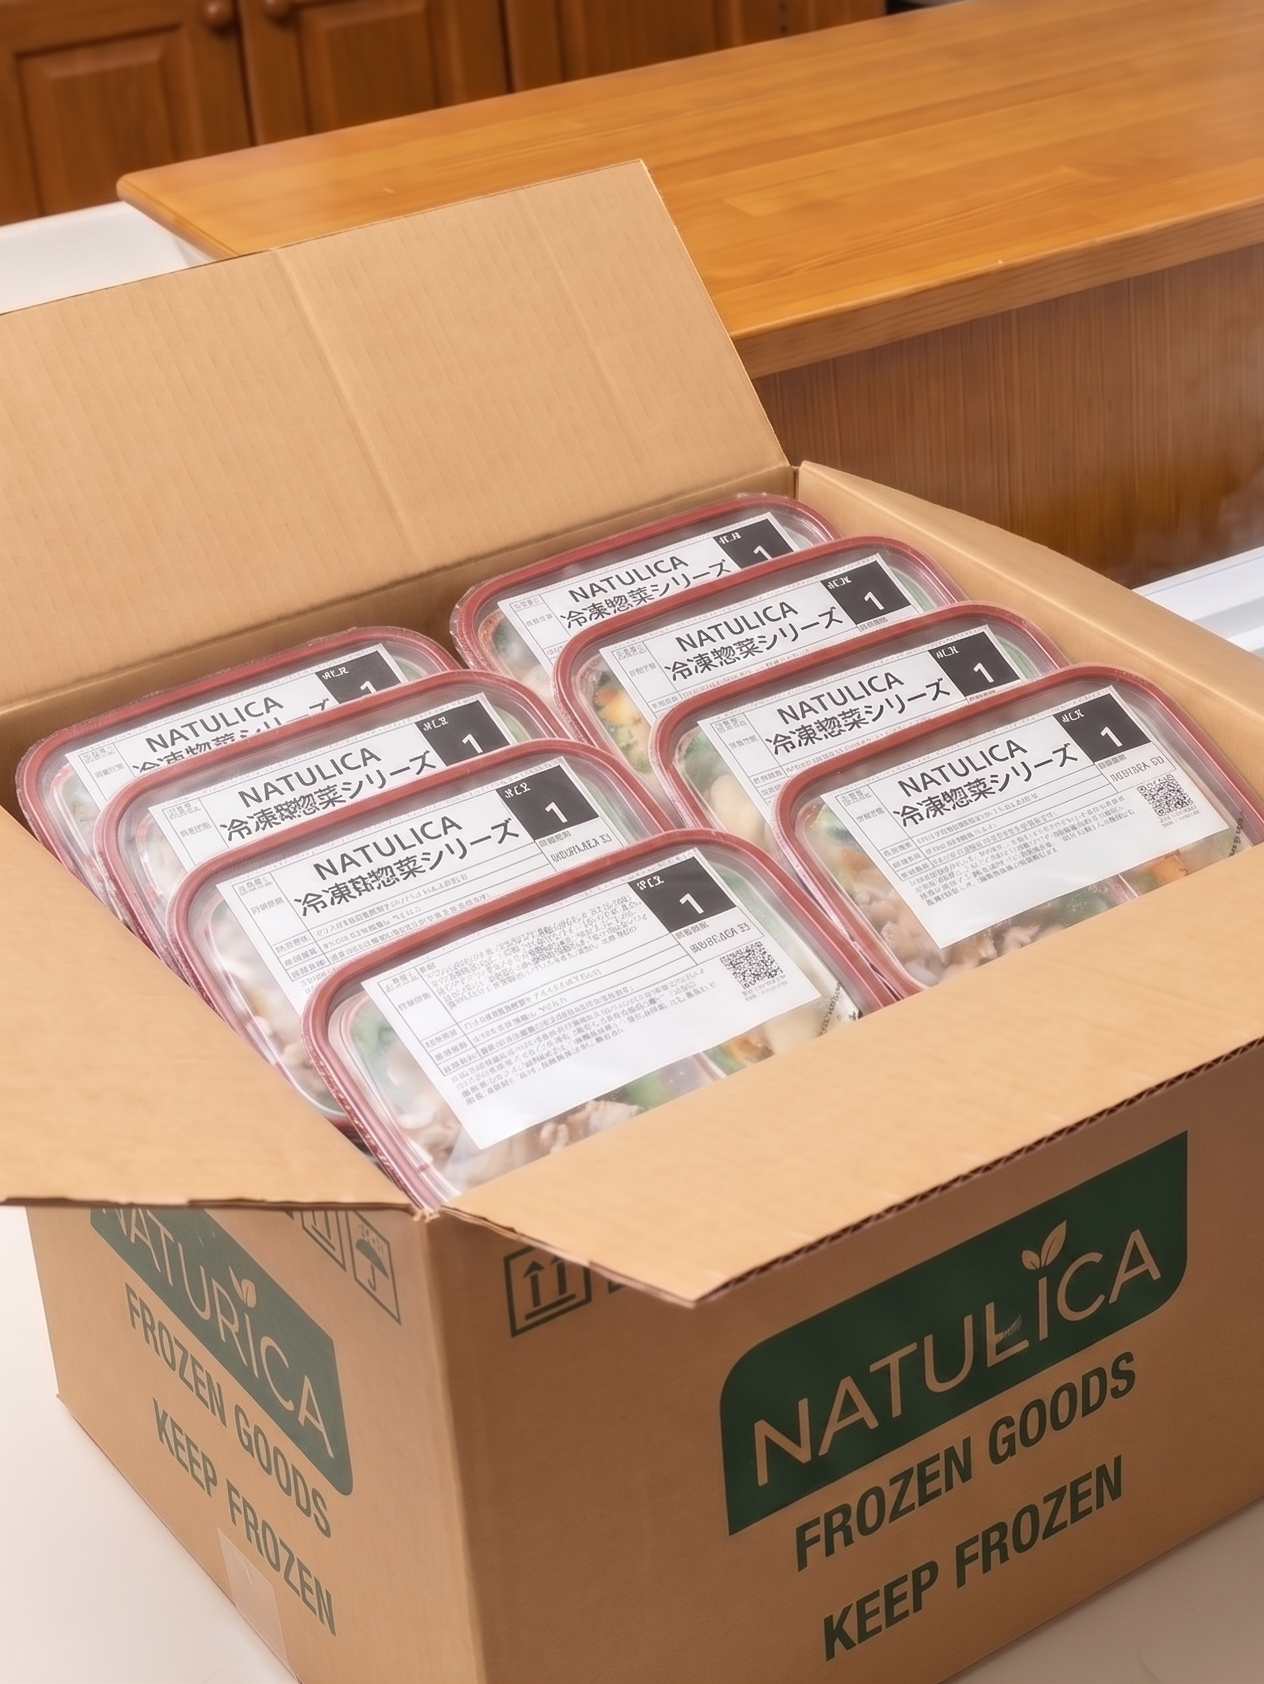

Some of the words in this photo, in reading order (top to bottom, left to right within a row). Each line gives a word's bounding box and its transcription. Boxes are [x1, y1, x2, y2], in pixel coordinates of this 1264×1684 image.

[568, 555, 689, 603] NATULICA
[863, 591, 885, 611] 1
[675, 601, 799, 652] NATULICA
[777, 672, 905, 725] NATULICA
[973, 662, 995, 684] 1
[145, 697, 284, 753] NATULICA
[461, 733, 483, 754] 1
[1100, 727, 1123, 748] 1
[238, 747, 382, 808] NATULICA
[897, 739, 1028, 797] NATULICA
[544, 802, 568, 824] 1
[313, 815, 463, 881] NATULICA
[679, 893, 705, 914] 1
[753, 1229, 1162, 1487] NATULICA
[124, 1281, 227, 1428] FROZEN
[234, 1404, 331, 1538] GOODS
[795, 1435, 973, 1573] FROZEN
[988, 1351, 1136, 1466] GOODS
[152, 1397, 218, 1498] KEEP
[225, 1477, 337, 1637] FROZEN
[823, 1560, 939, 1662] KEEP
[955, 1455, 1122, 1589] FROZEN
